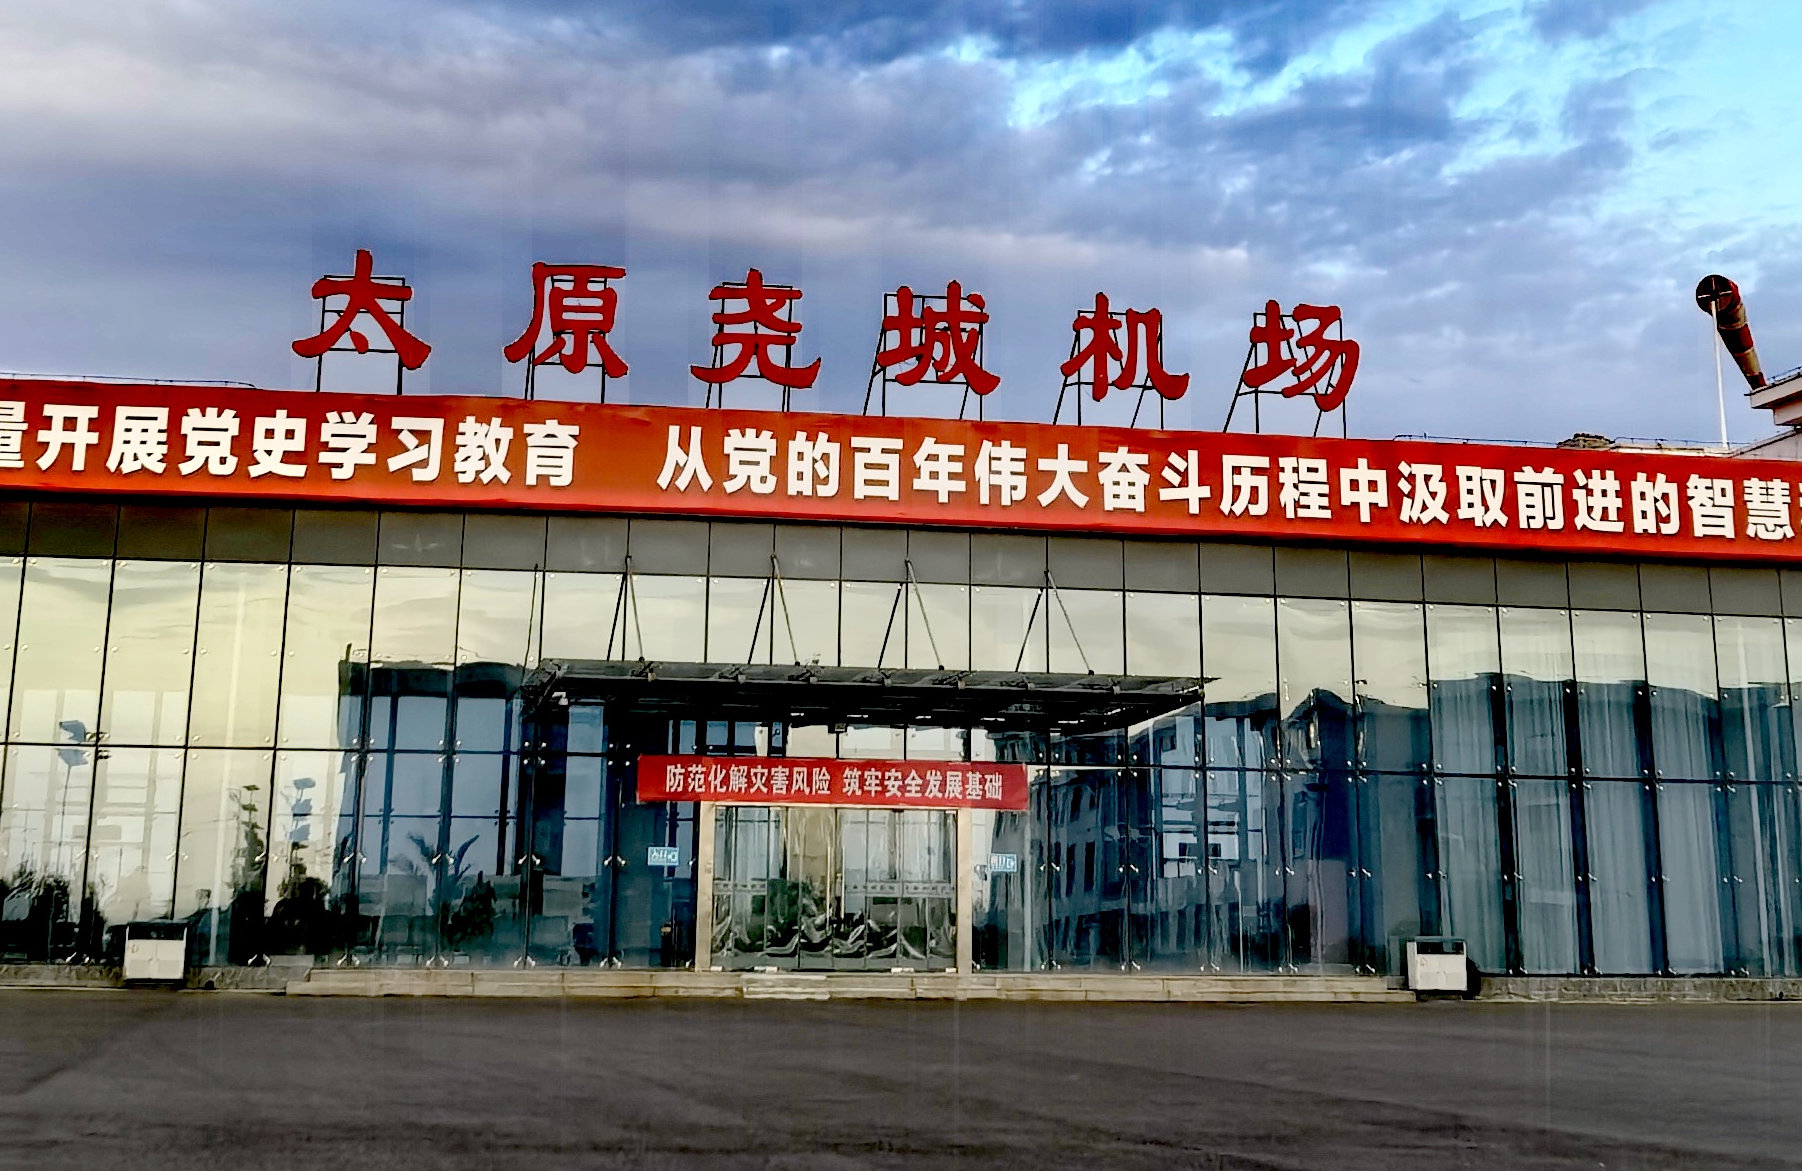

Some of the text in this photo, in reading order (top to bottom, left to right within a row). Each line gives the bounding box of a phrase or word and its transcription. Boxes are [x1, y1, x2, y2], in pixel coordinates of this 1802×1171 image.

[291, 248, 1362, 410] 太原尧城机场
[666, 763, 1003, 800] 防范化解灾害风险 筑牢安全发展基础
